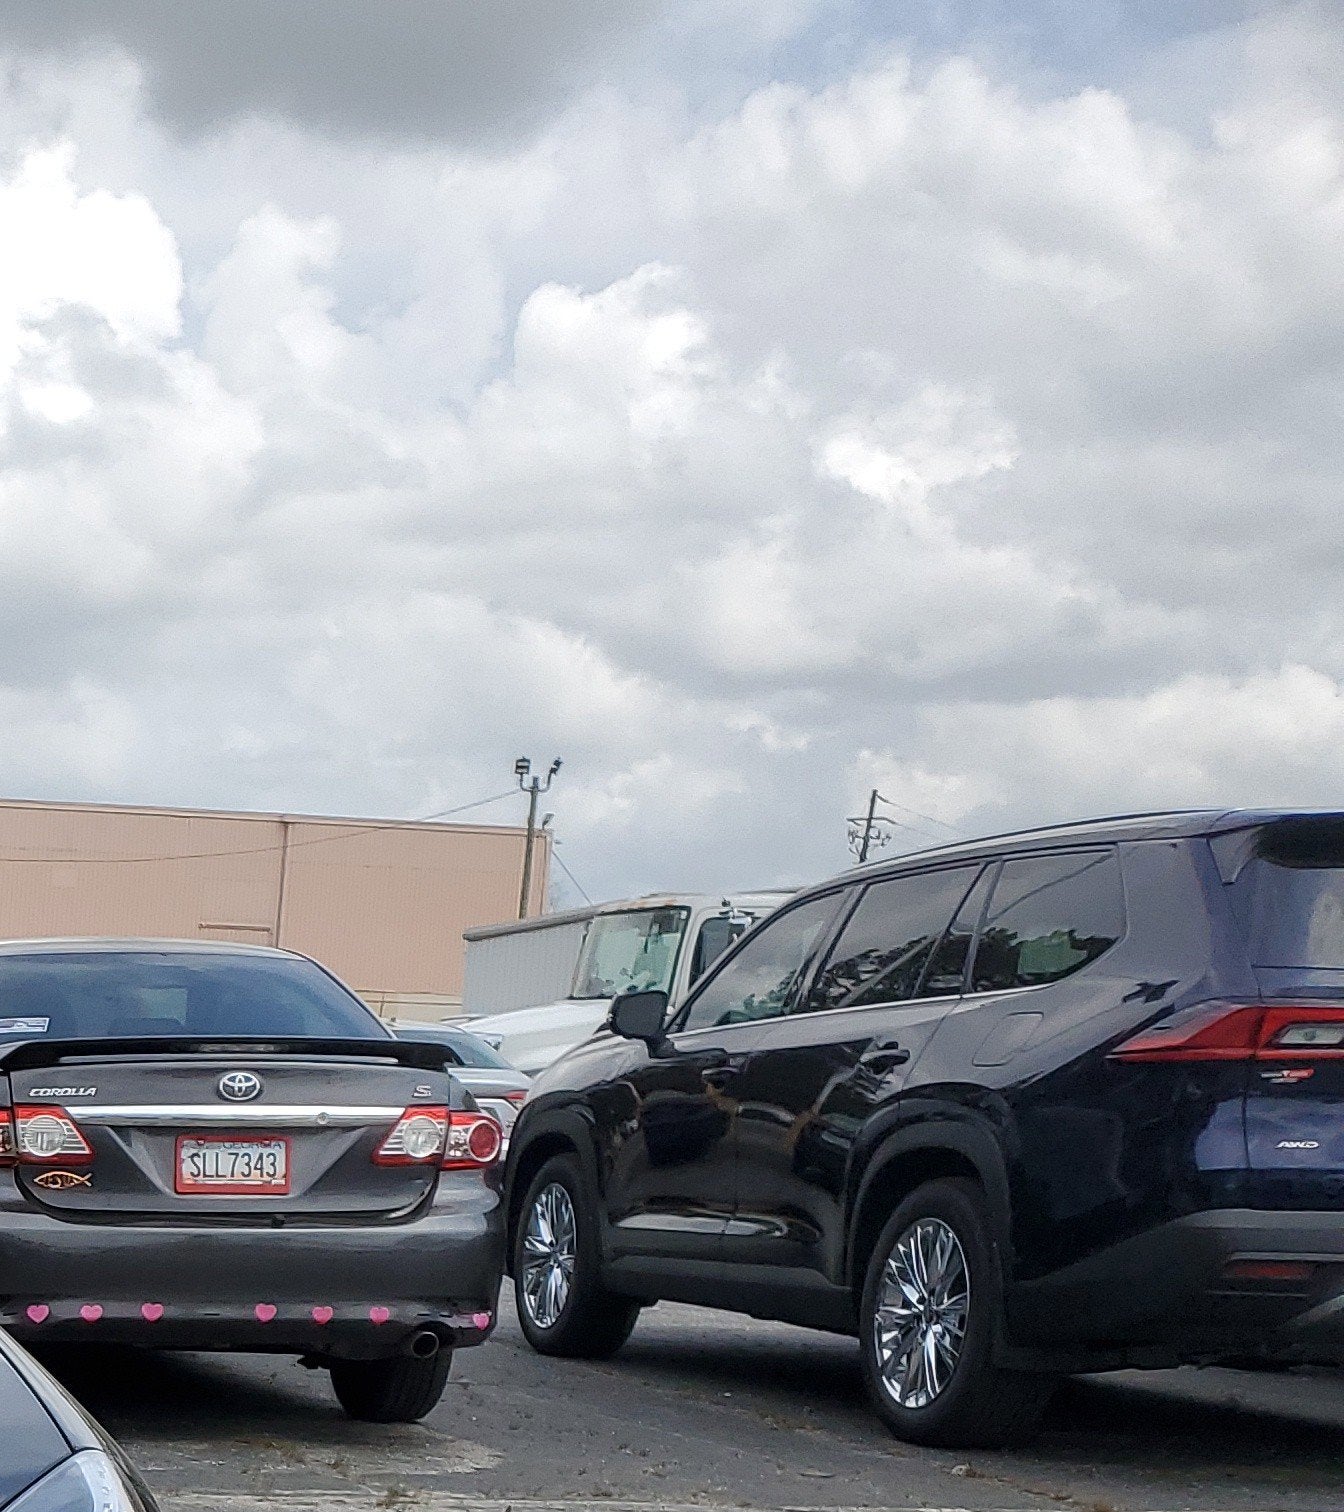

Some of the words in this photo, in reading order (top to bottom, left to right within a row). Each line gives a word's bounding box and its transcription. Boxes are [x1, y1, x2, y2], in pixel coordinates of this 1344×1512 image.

[29, 1087, 97, 1097] COROLLA
[413, 1085, 431, 1097] S
[1275, 1141, 1319, 1149] AWD
[188, 1152, 277, 1178] SLL7343
